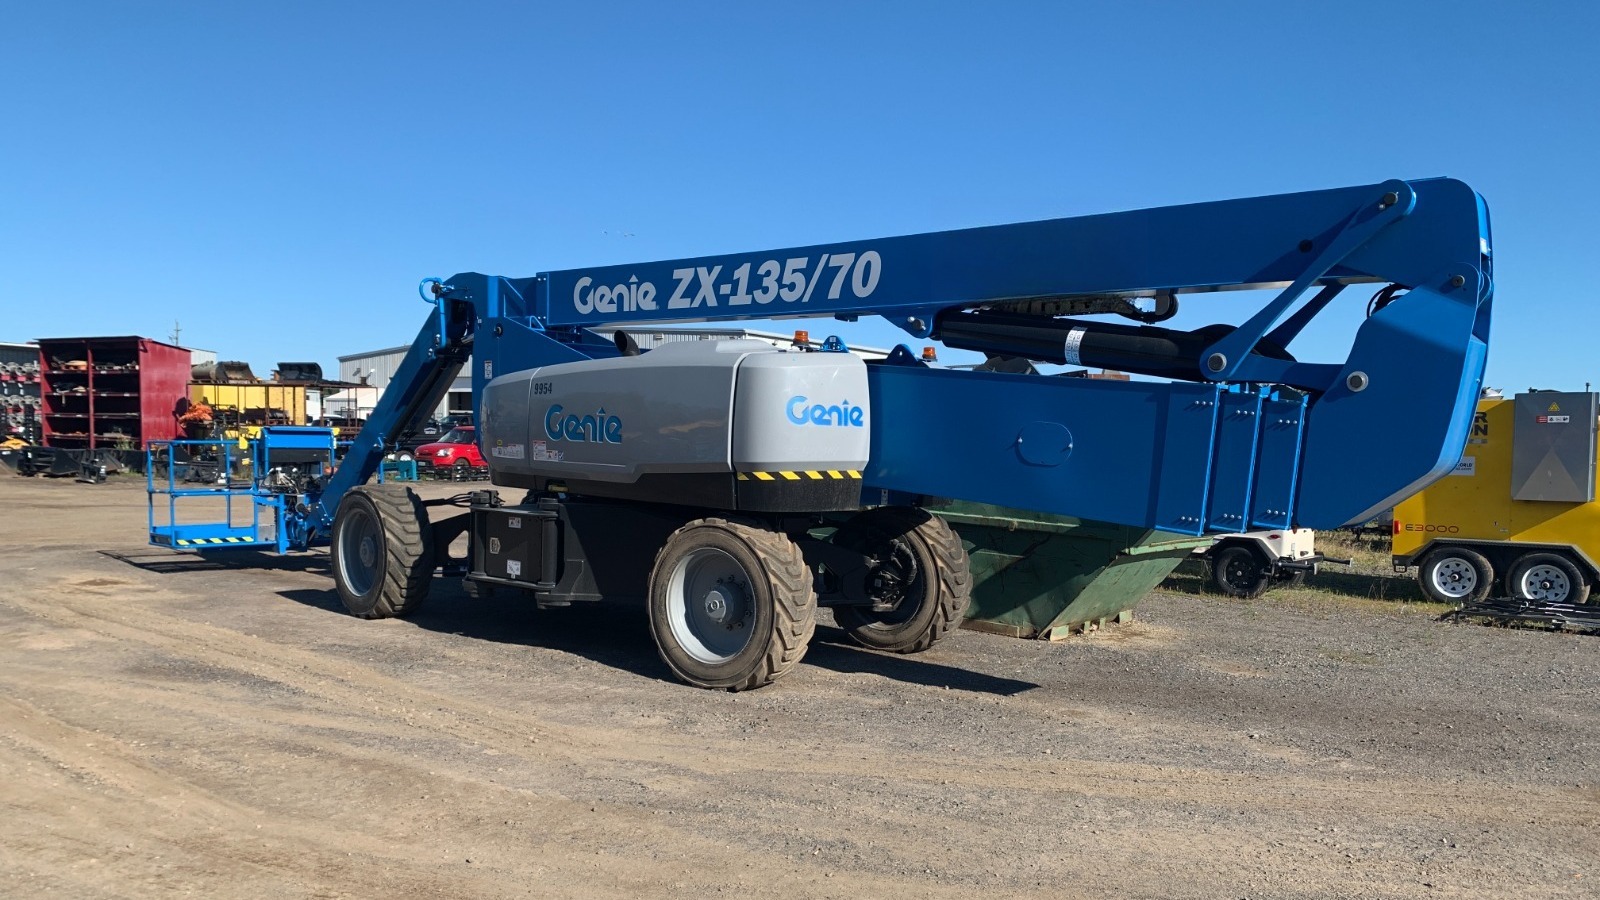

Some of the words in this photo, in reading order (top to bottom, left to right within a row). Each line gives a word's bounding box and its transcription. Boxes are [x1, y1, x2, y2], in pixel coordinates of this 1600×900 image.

[573, 273, 658, 315] Genie
[667, 250, 882, 310] ZX-135/70
[534, 382, 552, 395] 9954
[544, 404, 622, 444] Genie
[785, 395, 863, 427] Genie
[1405, 523, 1459, 533] E3000
